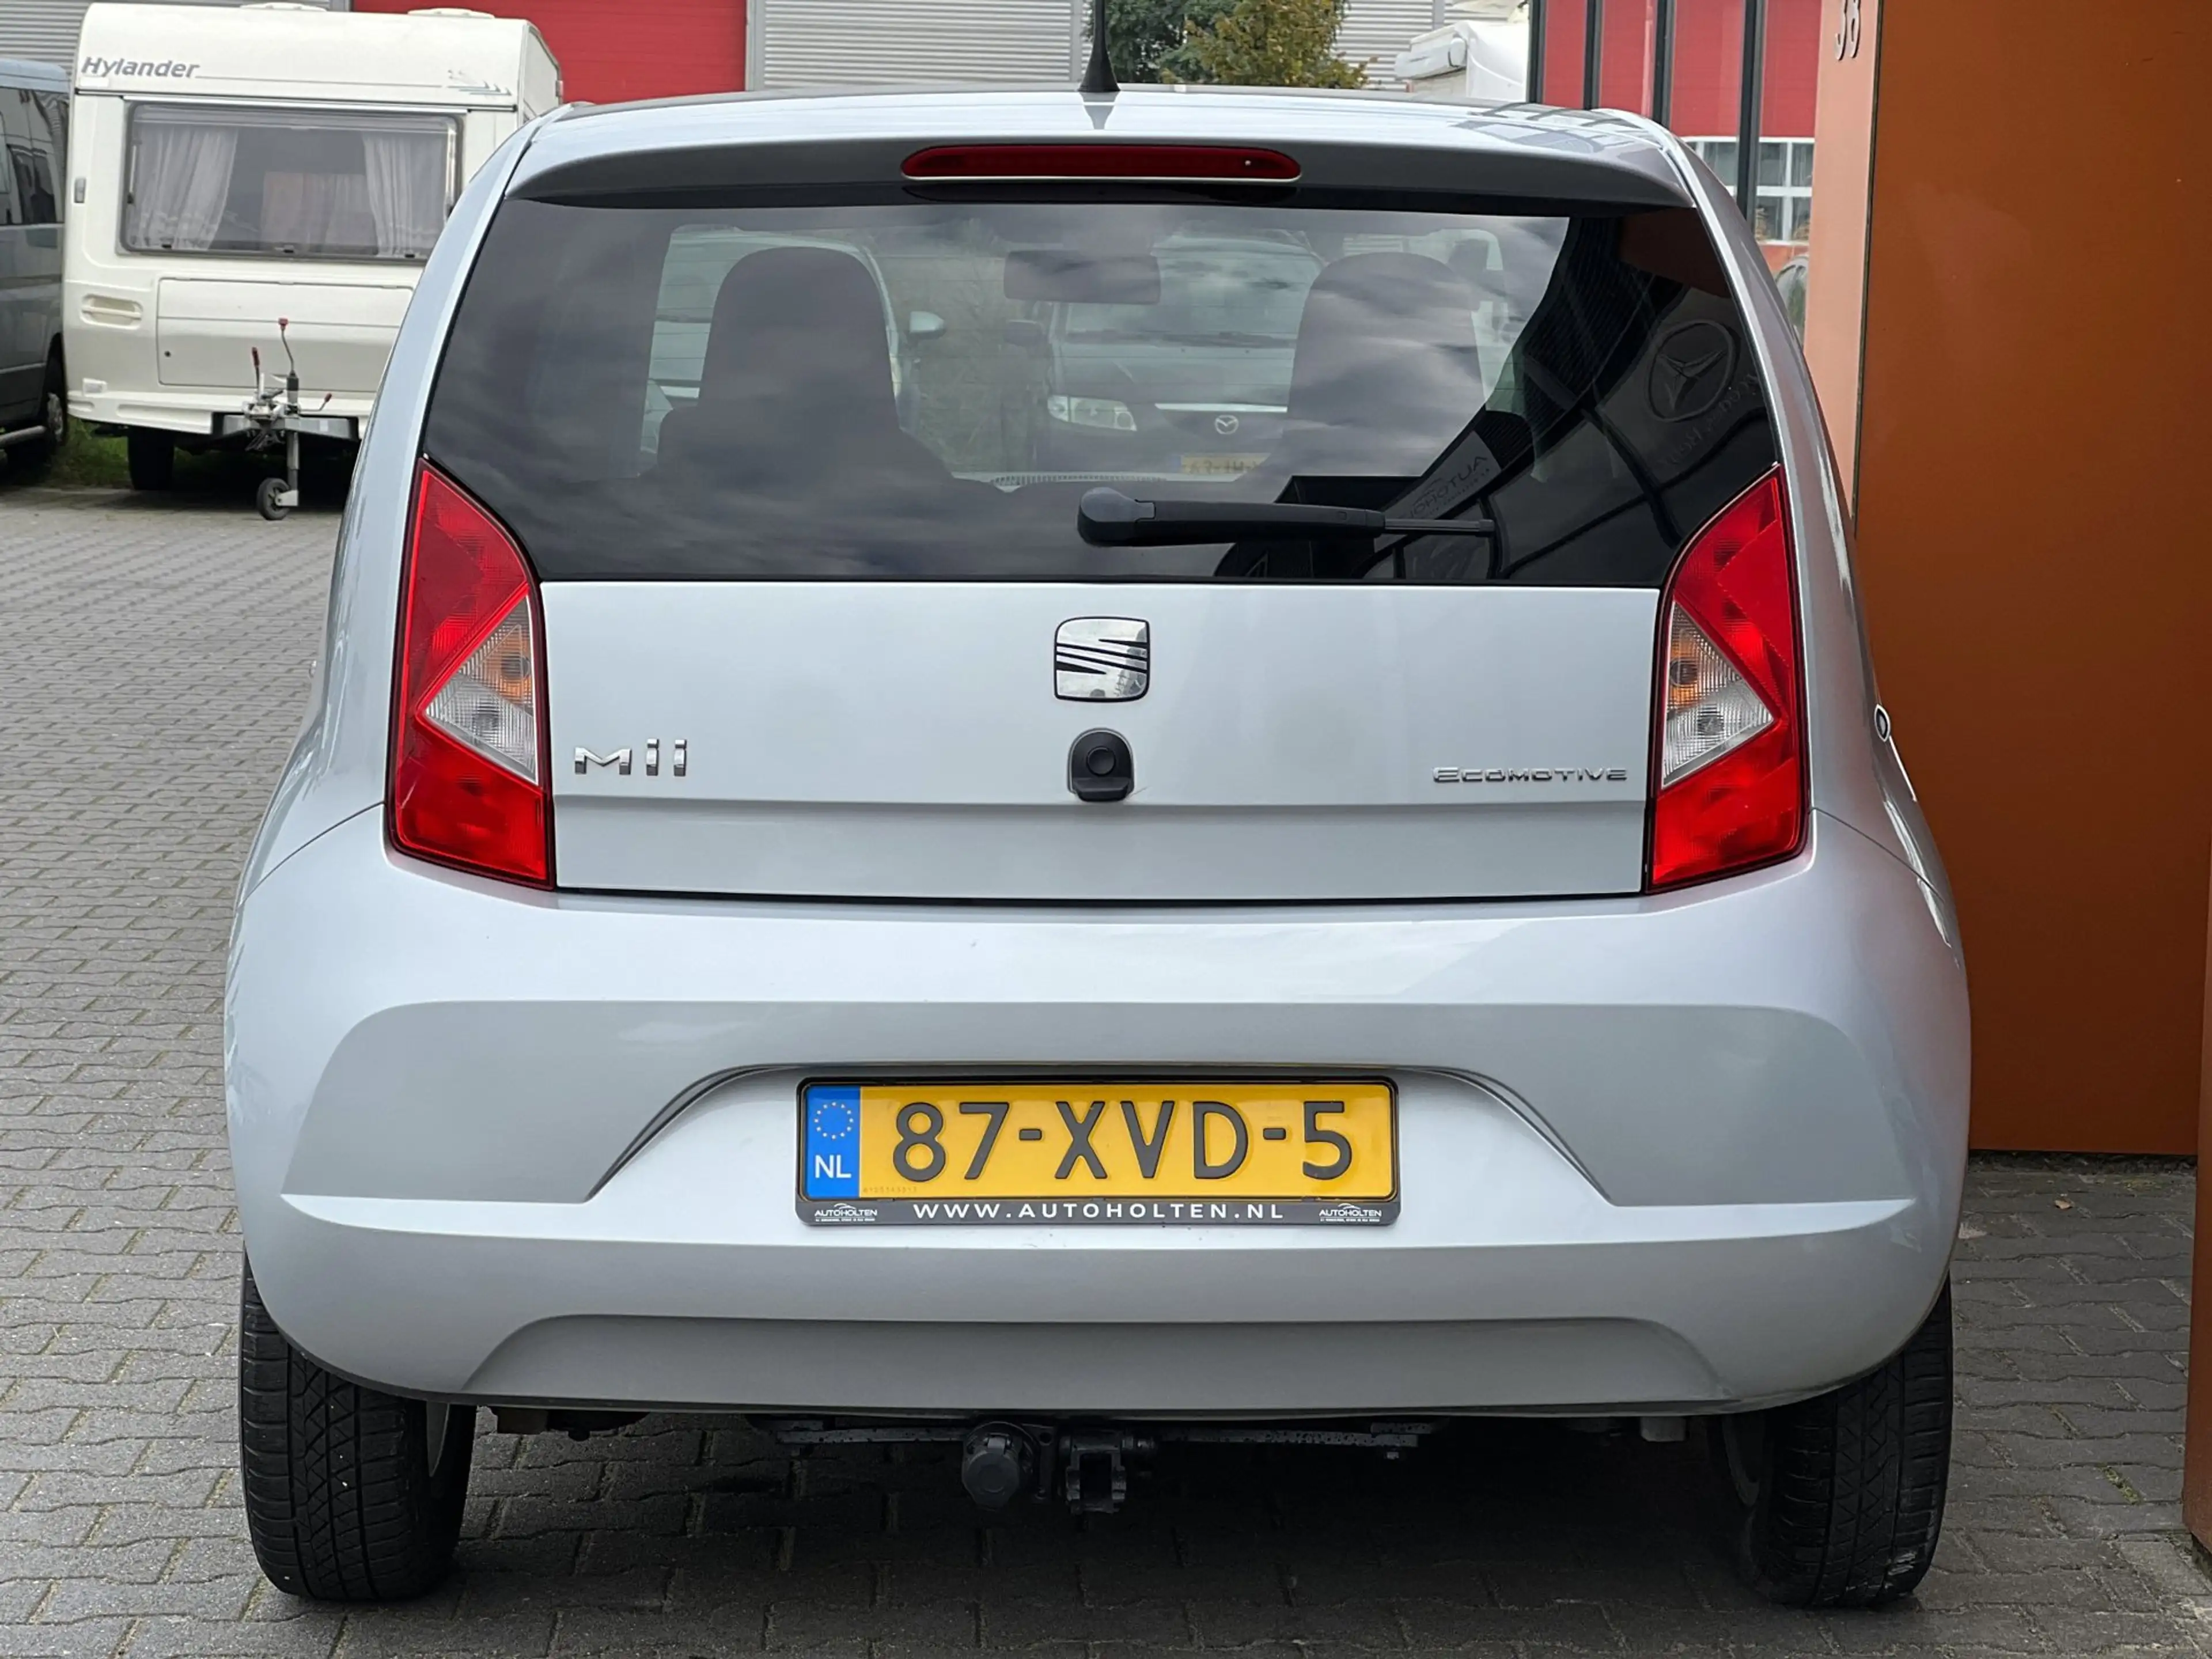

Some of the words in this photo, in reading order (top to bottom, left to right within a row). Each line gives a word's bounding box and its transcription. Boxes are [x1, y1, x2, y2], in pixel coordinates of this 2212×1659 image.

[81, 57, 200, 78] Hylander
[574, 738, 688, 777] Mii
[893, 1101, 1353, 1182] 87-XVD-5
[815, 1155, 851, 1179] NL
[913, 1203, 1283, 1219] WWW.AUTOHOLTEN.NL
